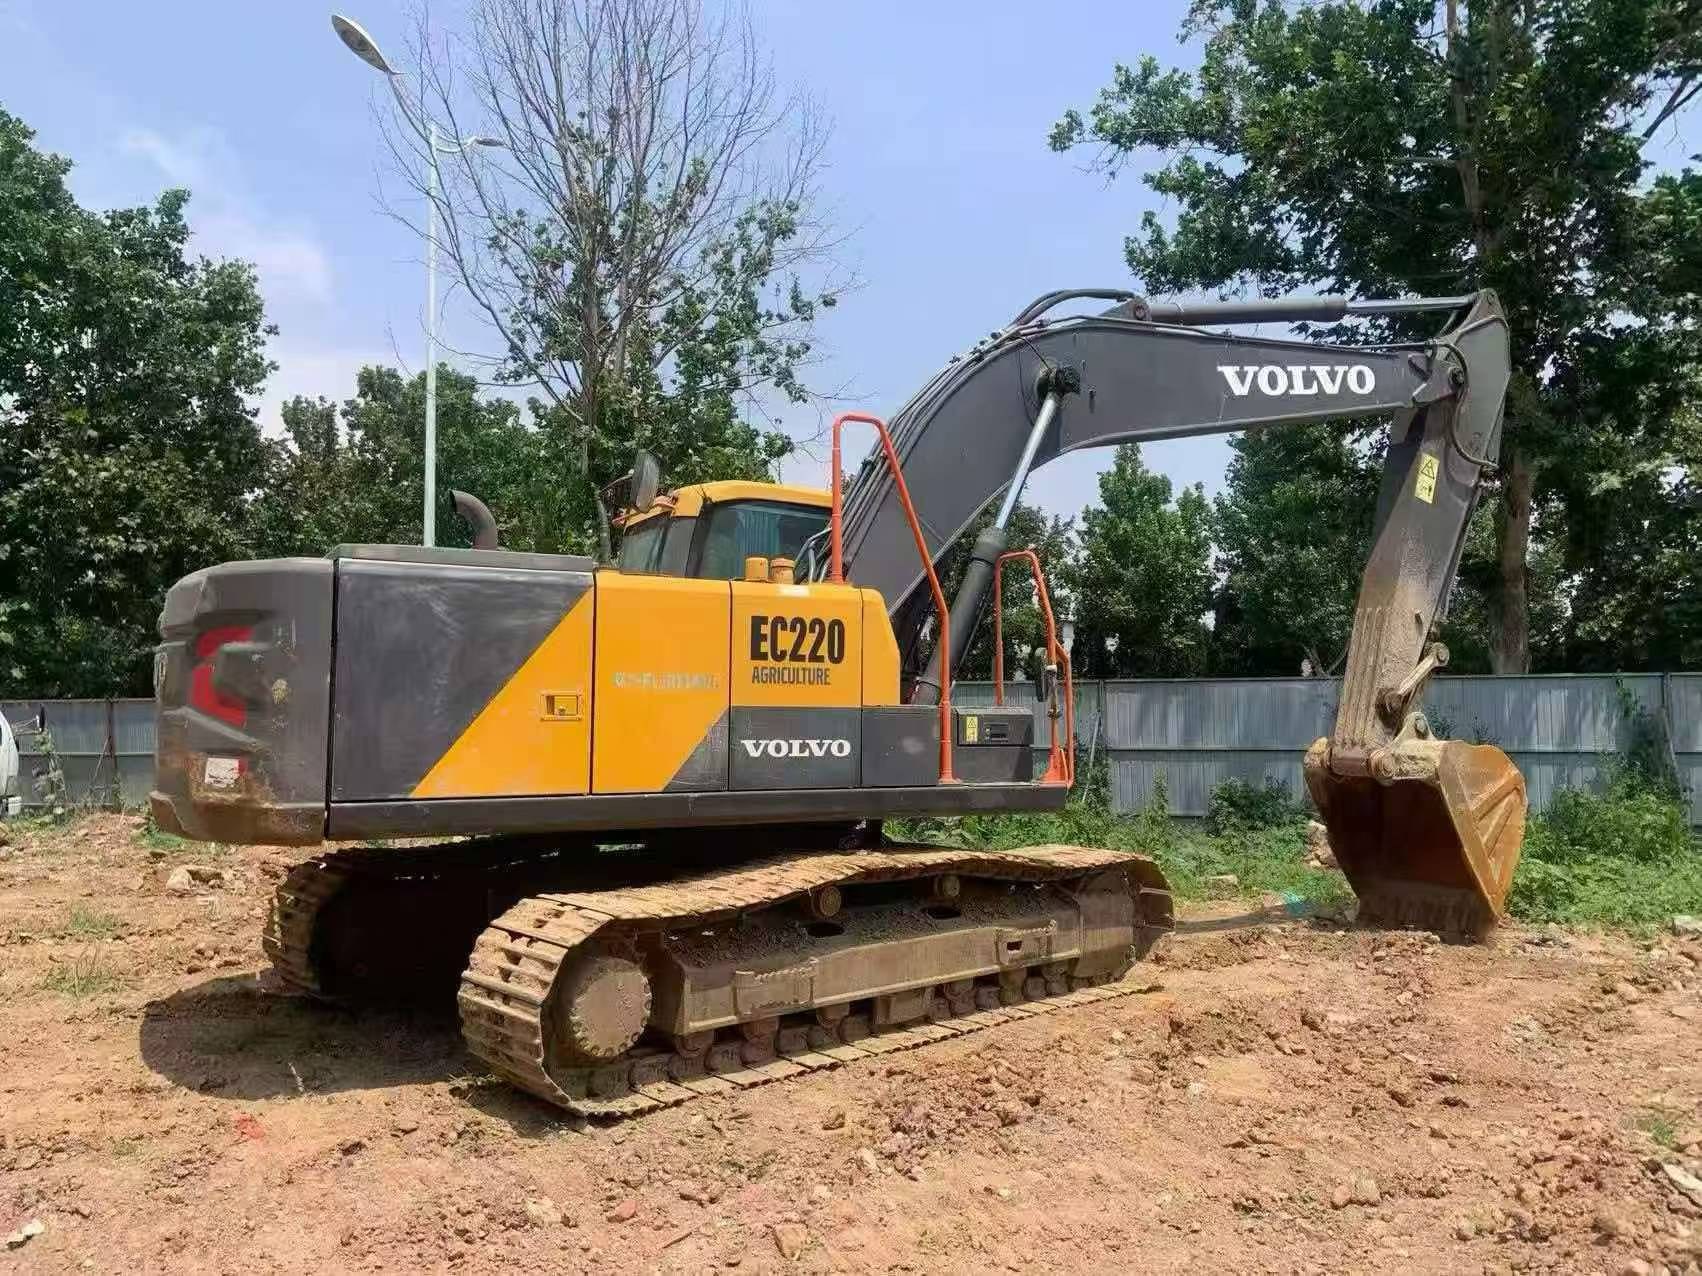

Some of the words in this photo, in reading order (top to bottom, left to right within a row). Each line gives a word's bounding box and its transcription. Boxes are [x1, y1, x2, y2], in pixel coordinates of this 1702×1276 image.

[1217, 365, 1376, 396] VOLVO
[750, 615, 845, 664] EC220
[751, 666, 831, 685] AGRICULTURE
[741, 739, 851, 758] VOLVO
